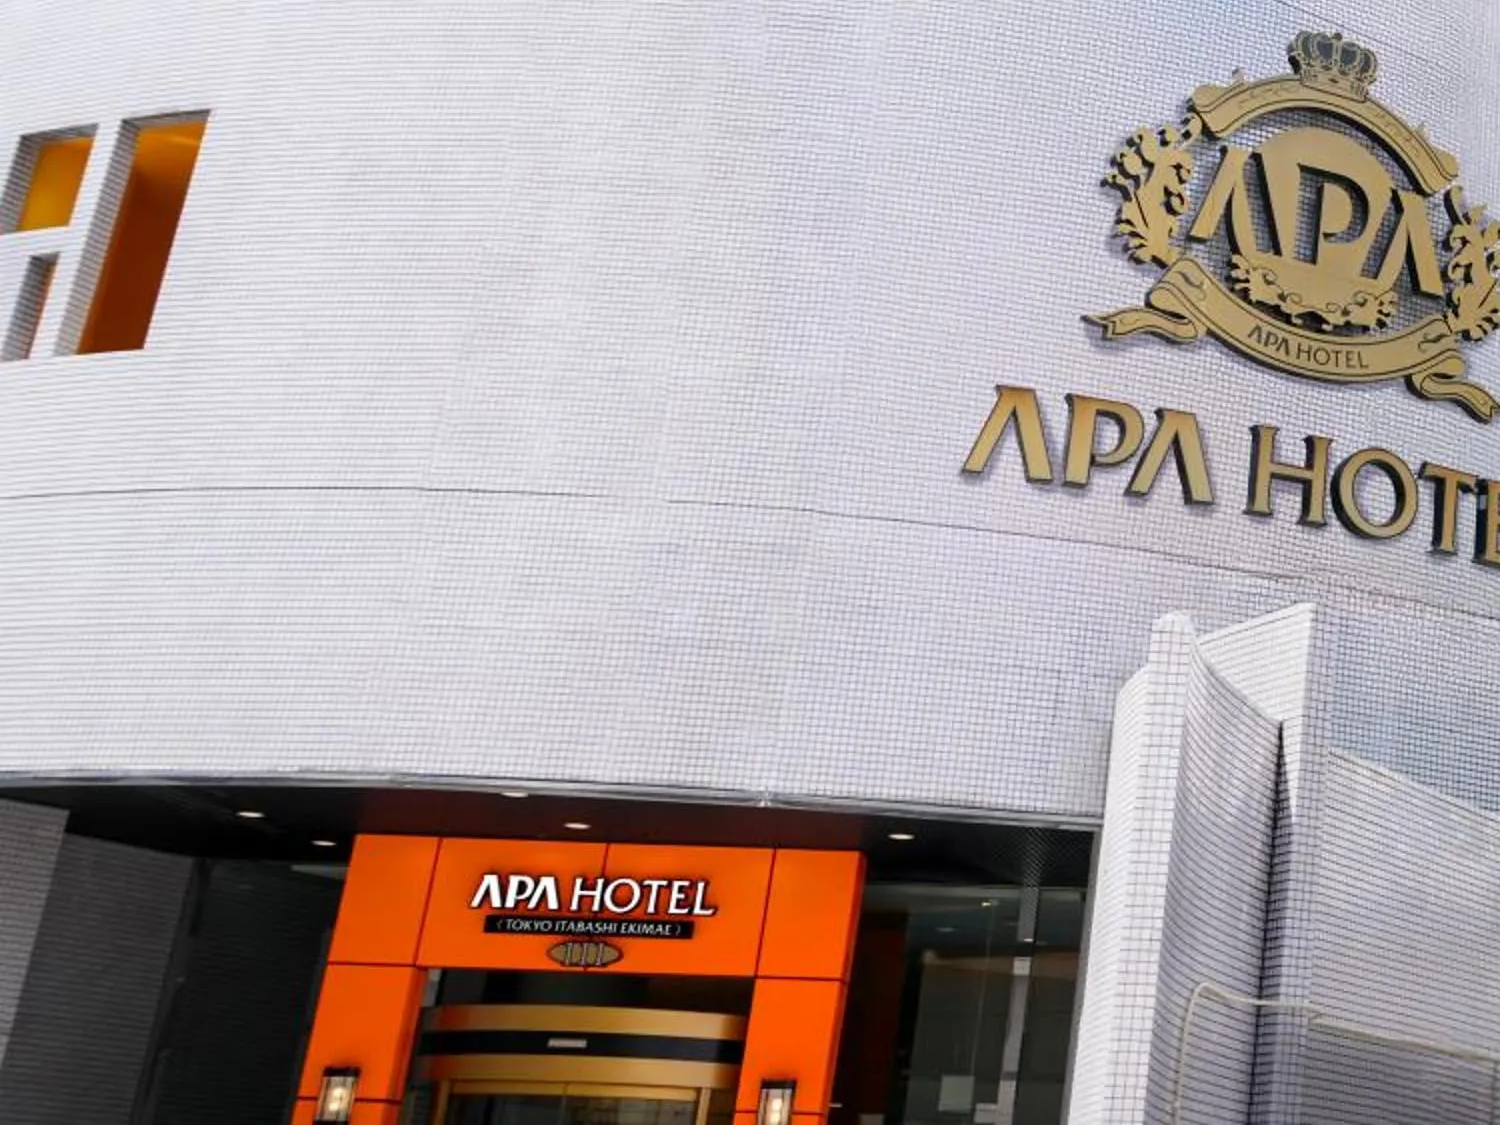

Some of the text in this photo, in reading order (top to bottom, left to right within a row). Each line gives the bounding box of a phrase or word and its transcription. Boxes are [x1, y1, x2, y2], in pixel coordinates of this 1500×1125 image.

[1188, 145, 1445, 298] APA
[1248, 324, 1369, 369] APA HOTEL
[961, 385, 1214, 504] APA
[470, 874, 715, 916] APA HOTEL
[554, 920, 618, 935] ITABASHI
